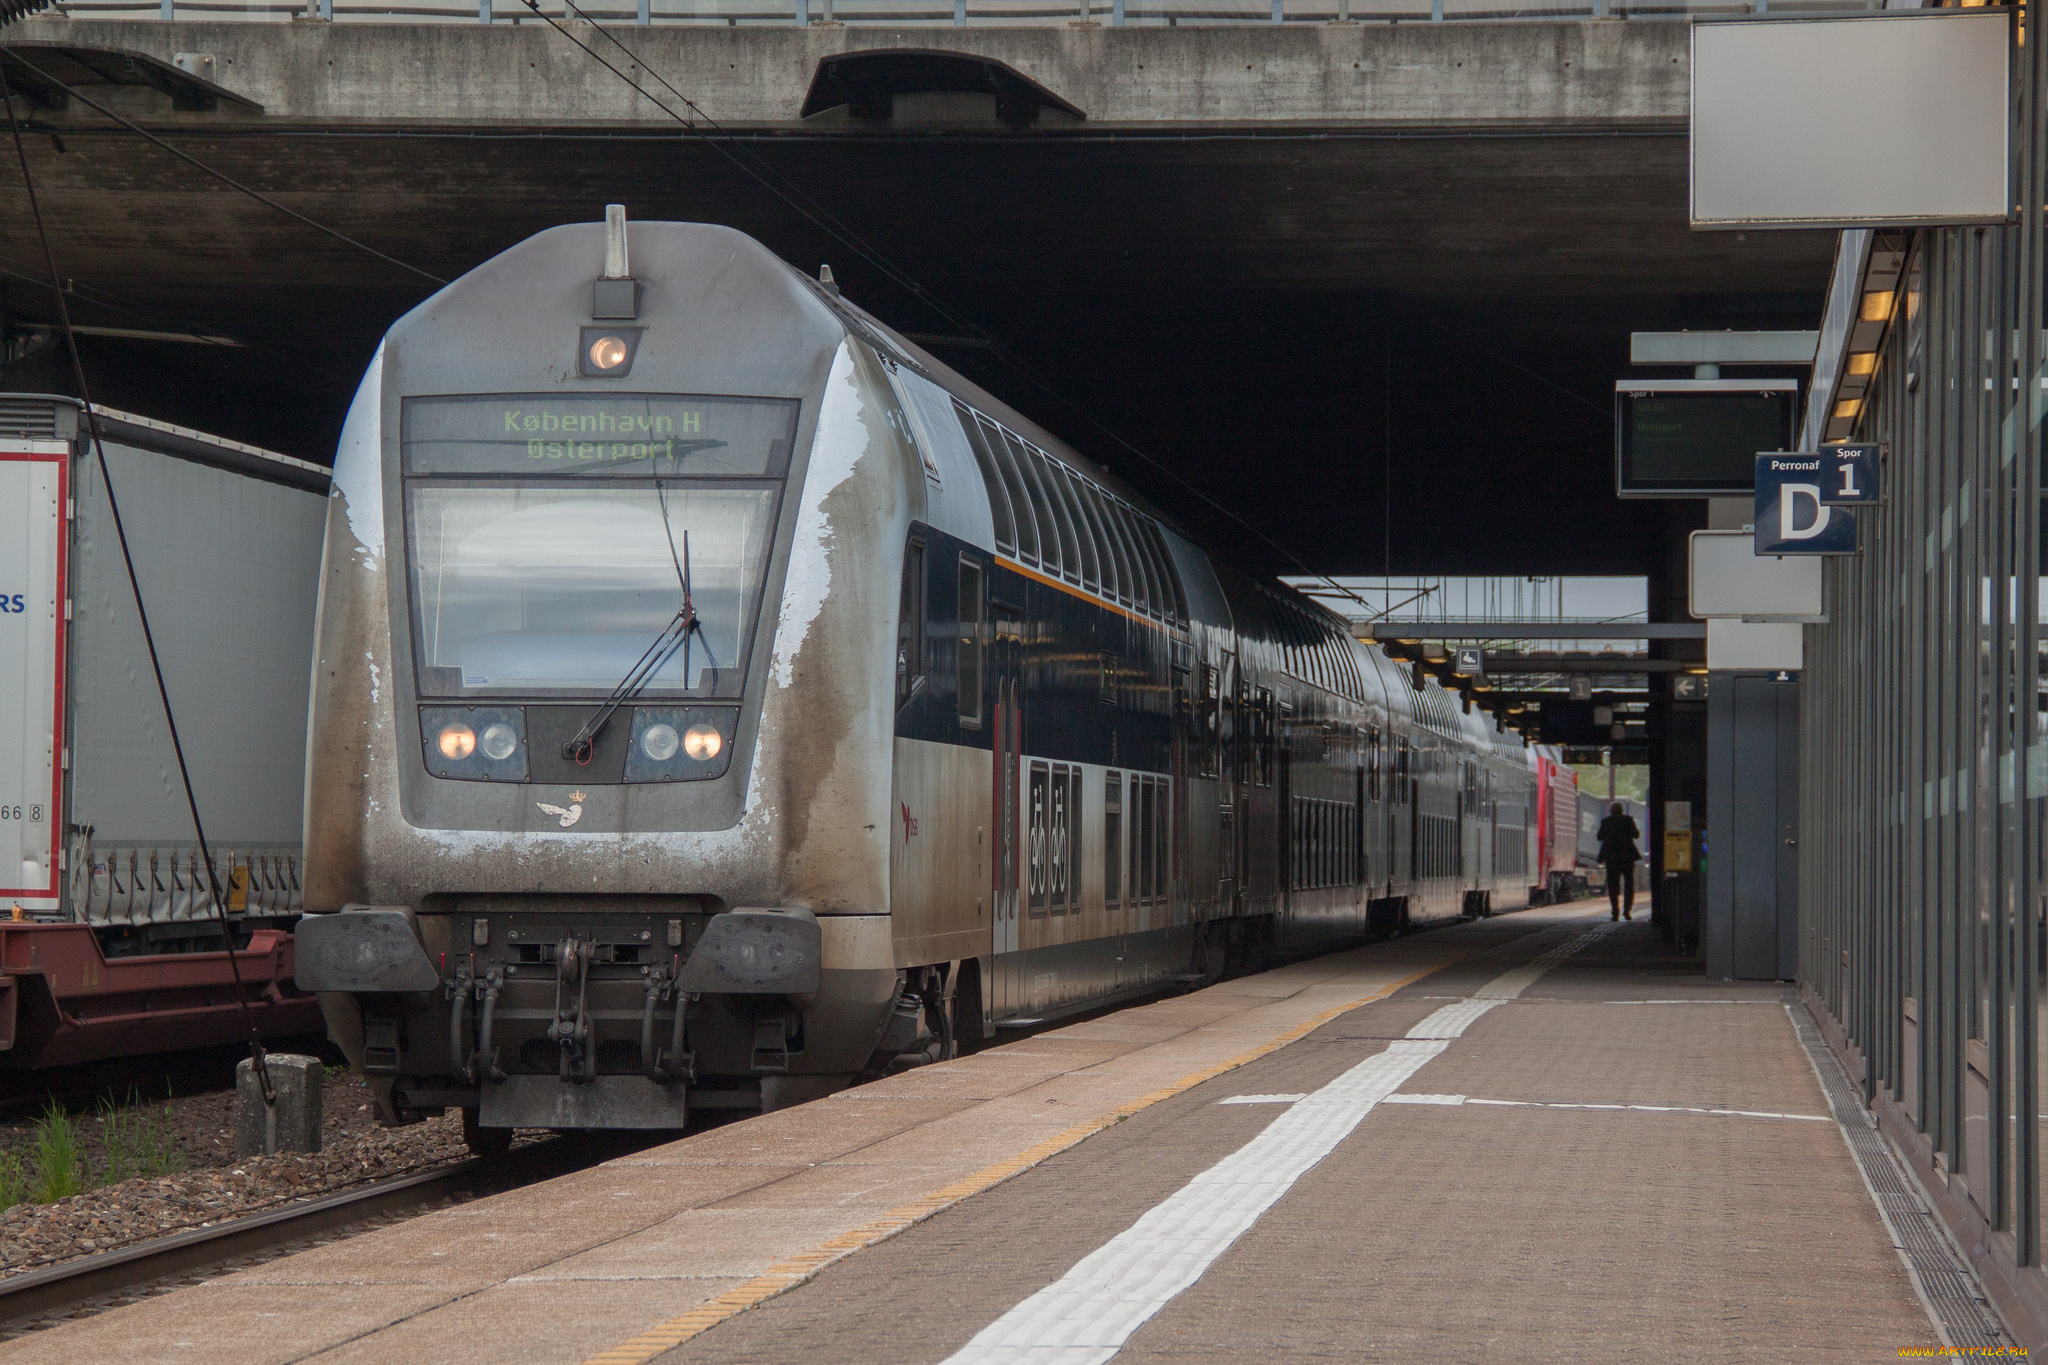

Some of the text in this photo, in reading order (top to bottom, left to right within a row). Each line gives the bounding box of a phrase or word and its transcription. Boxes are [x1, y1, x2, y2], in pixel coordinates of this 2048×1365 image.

[504, 410, 700, 433] København H
[527, 437, 674, 461] Østerport
[1836, 447, 1862, 460] Spor
[1838, 463, 1860, 496] 1
[1780, 483, 1831, 540] D
[32, 806, 41, 820] 8
